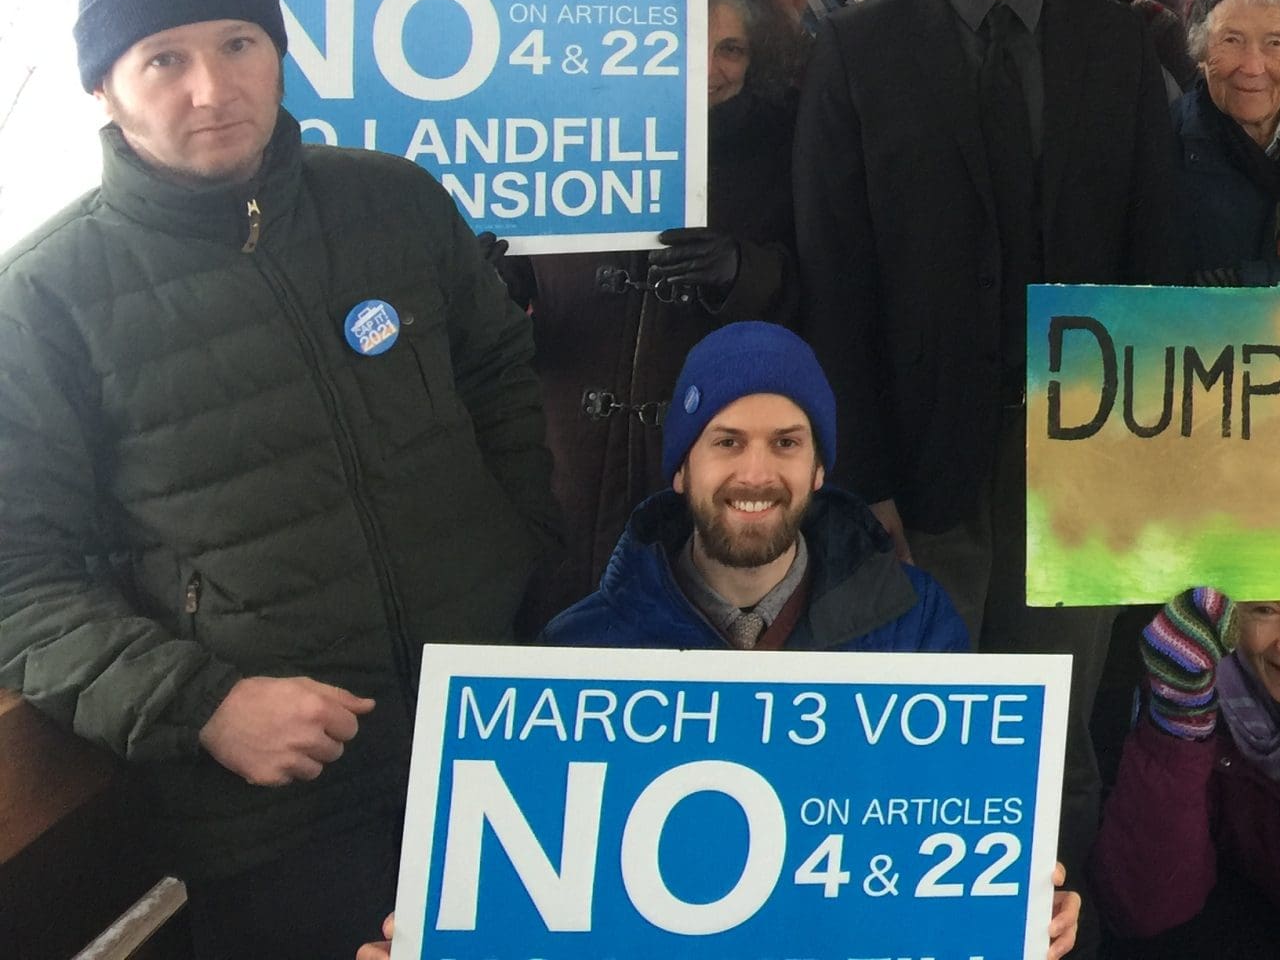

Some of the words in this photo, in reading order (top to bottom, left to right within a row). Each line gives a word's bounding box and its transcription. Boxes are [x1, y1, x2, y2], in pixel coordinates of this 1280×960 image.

[509, 2, 547, 25] ON
[557, 4, 678, 26] ARTICLES
[508, 29, 551, 75] 4
[561, 44, 589, 75] &
[600, 29, 680, 76] 22
[441, 169, 662, 219] NSION!
[456, 686, 719, 743] MARCH
[755, 690, 828, 746] 13
[855, 692, 1029, 747] VOTE
[800, 797, 850, 826] ON
[861, 797, 1023, 826] ARTICLES
[435, 758, 788, 936] NO
[793, 833, 851, 898] 4
[862, 853, 900, 898] &
[914, 832, 1023, 898] 22
